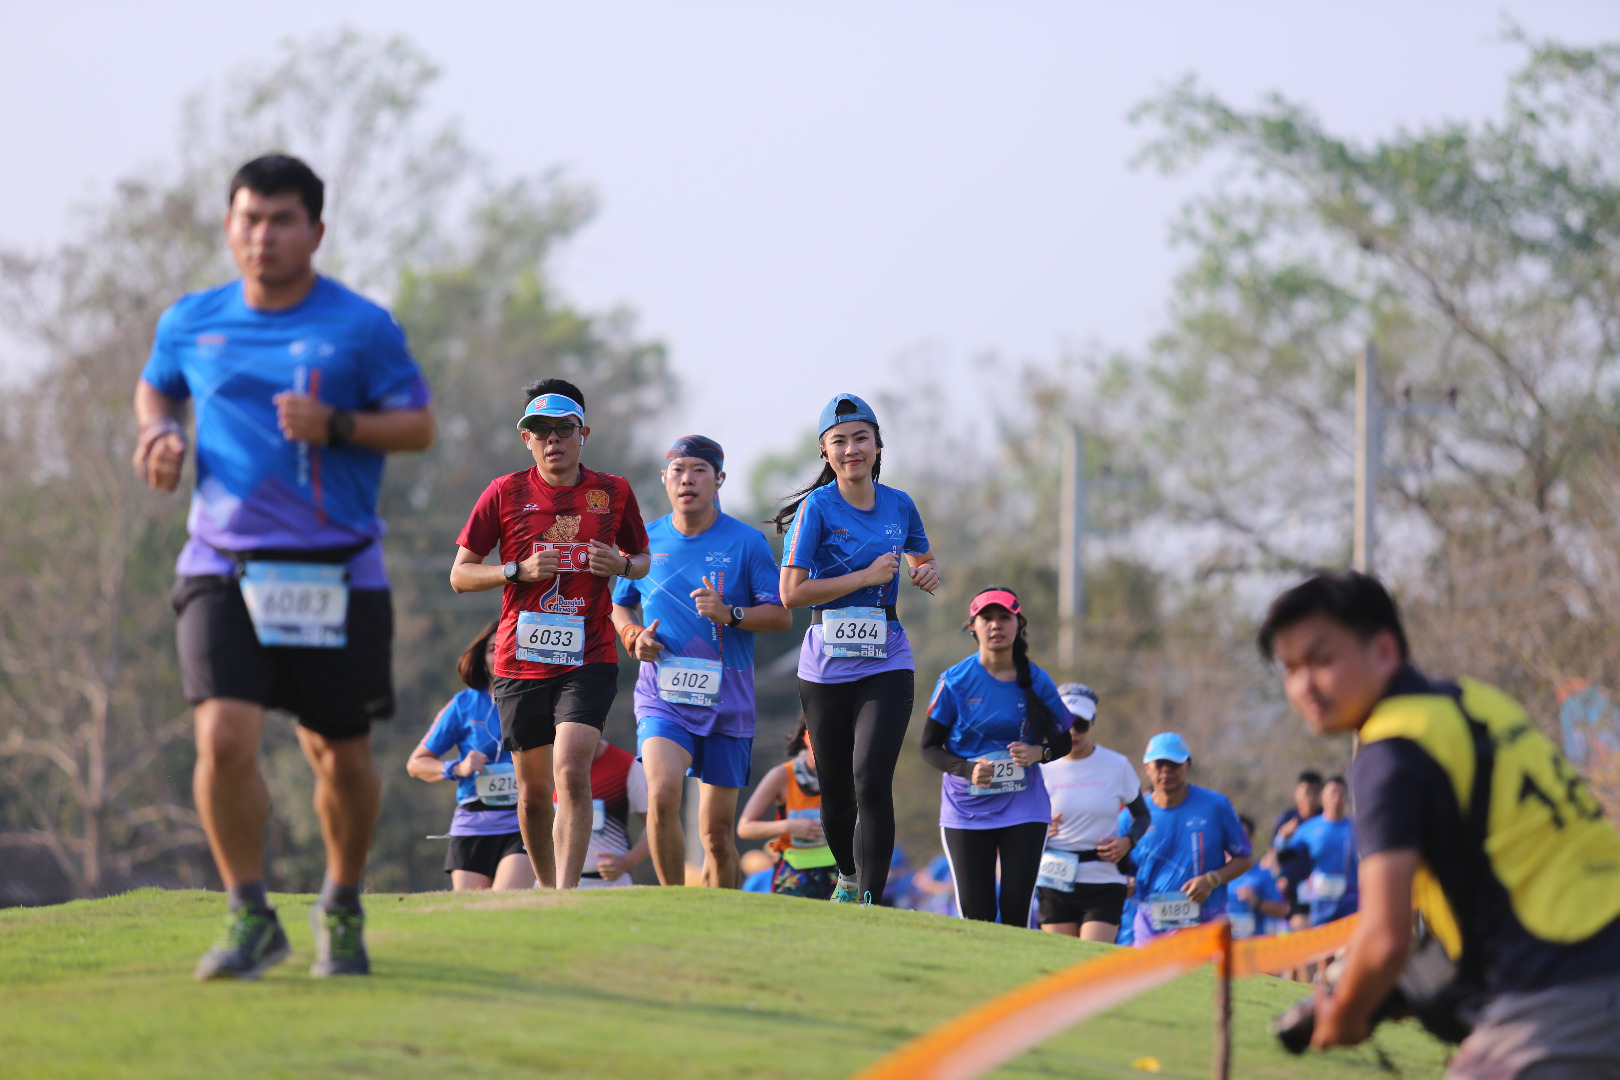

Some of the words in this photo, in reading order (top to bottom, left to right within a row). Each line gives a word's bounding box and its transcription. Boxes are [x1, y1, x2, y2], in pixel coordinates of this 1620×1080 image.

[534, 544, 591, 572] EO
[553, 603, 577, 615] Airways
[558, 595, 584, 607] Bangkok
[529, 628, 573, 647] 6033
[835, 622, 878, 640] 6364
[671, 671, 709, 689] 6102
[991, 762, 1014, 778] 125
[1160, 902, 1191, 917] 6180
